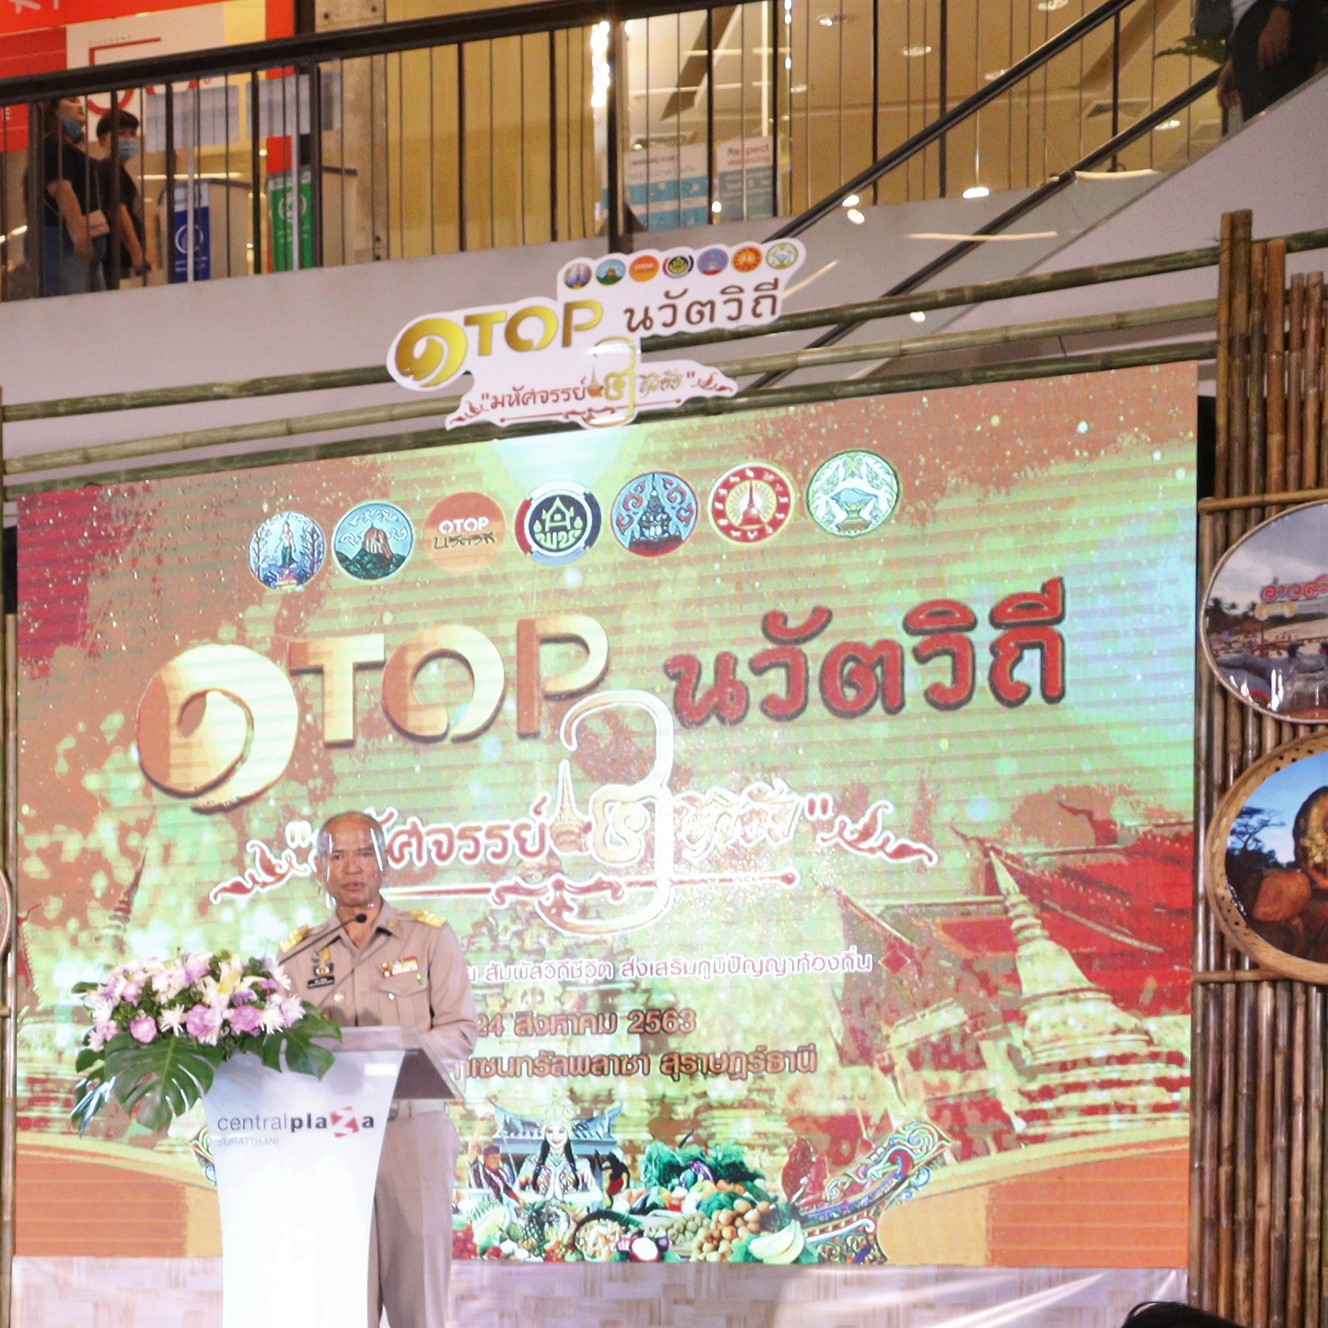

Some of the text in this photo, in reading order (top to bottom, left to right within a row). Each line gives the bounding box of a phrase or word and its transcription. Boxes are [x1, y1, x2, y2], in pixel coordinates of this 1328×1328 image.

[623, 277, 781, 334] นวัตวิถี
[439, 516, 490, 535] OTOP
[663, 575, 1066, 728] นวัตวิถี
[484, 954, 615, 981] สัมผัสวิถีชีวิต
[619, 944, 874, 982] ส่งเสริมภูมิปัญญาท้องถิ่น
[513, 1008, 617, 1037] สิงหาคม
[627, 1008, 696, 1035] 2563
[659, 1043, 818, 1082] สุราษฎร์ธานี
[217, 1107, 375, 1138] centralplaza
